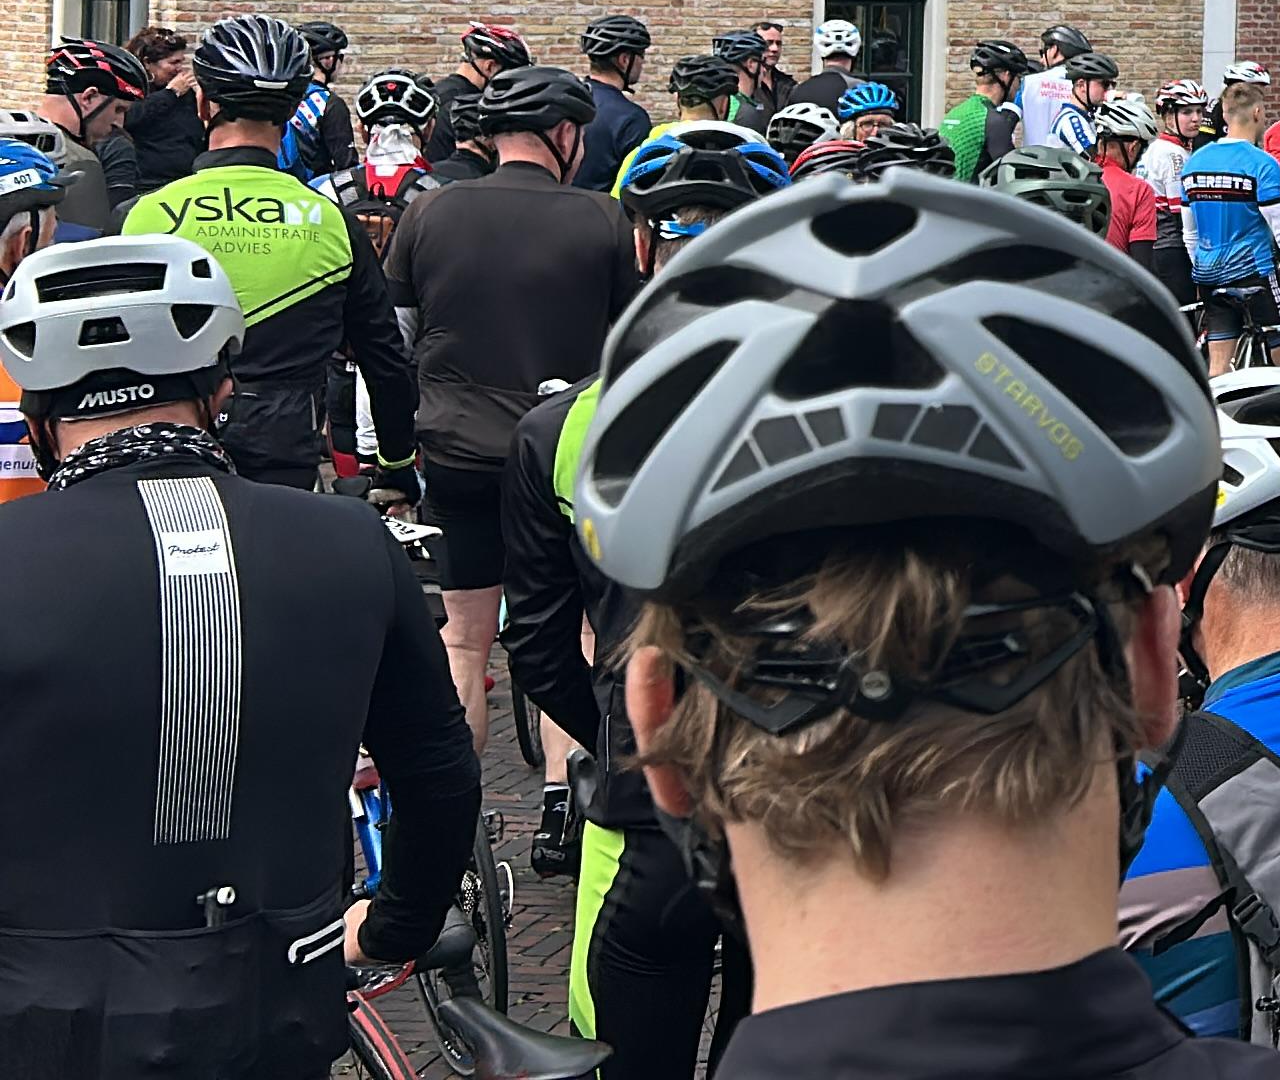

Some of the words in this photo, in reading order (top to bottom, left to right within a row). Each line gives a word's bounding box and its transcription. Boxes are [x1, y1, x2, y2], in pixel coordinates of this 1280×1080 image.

[196, 225, 320, 243] ADMINISTRATIE
[213, 242, 272, 254] ADVIES
[77, 384, 155, 409] MUSTO
[975, 351, 1085, 461] STARVOS
[168, 541, 220, 556] Protest
